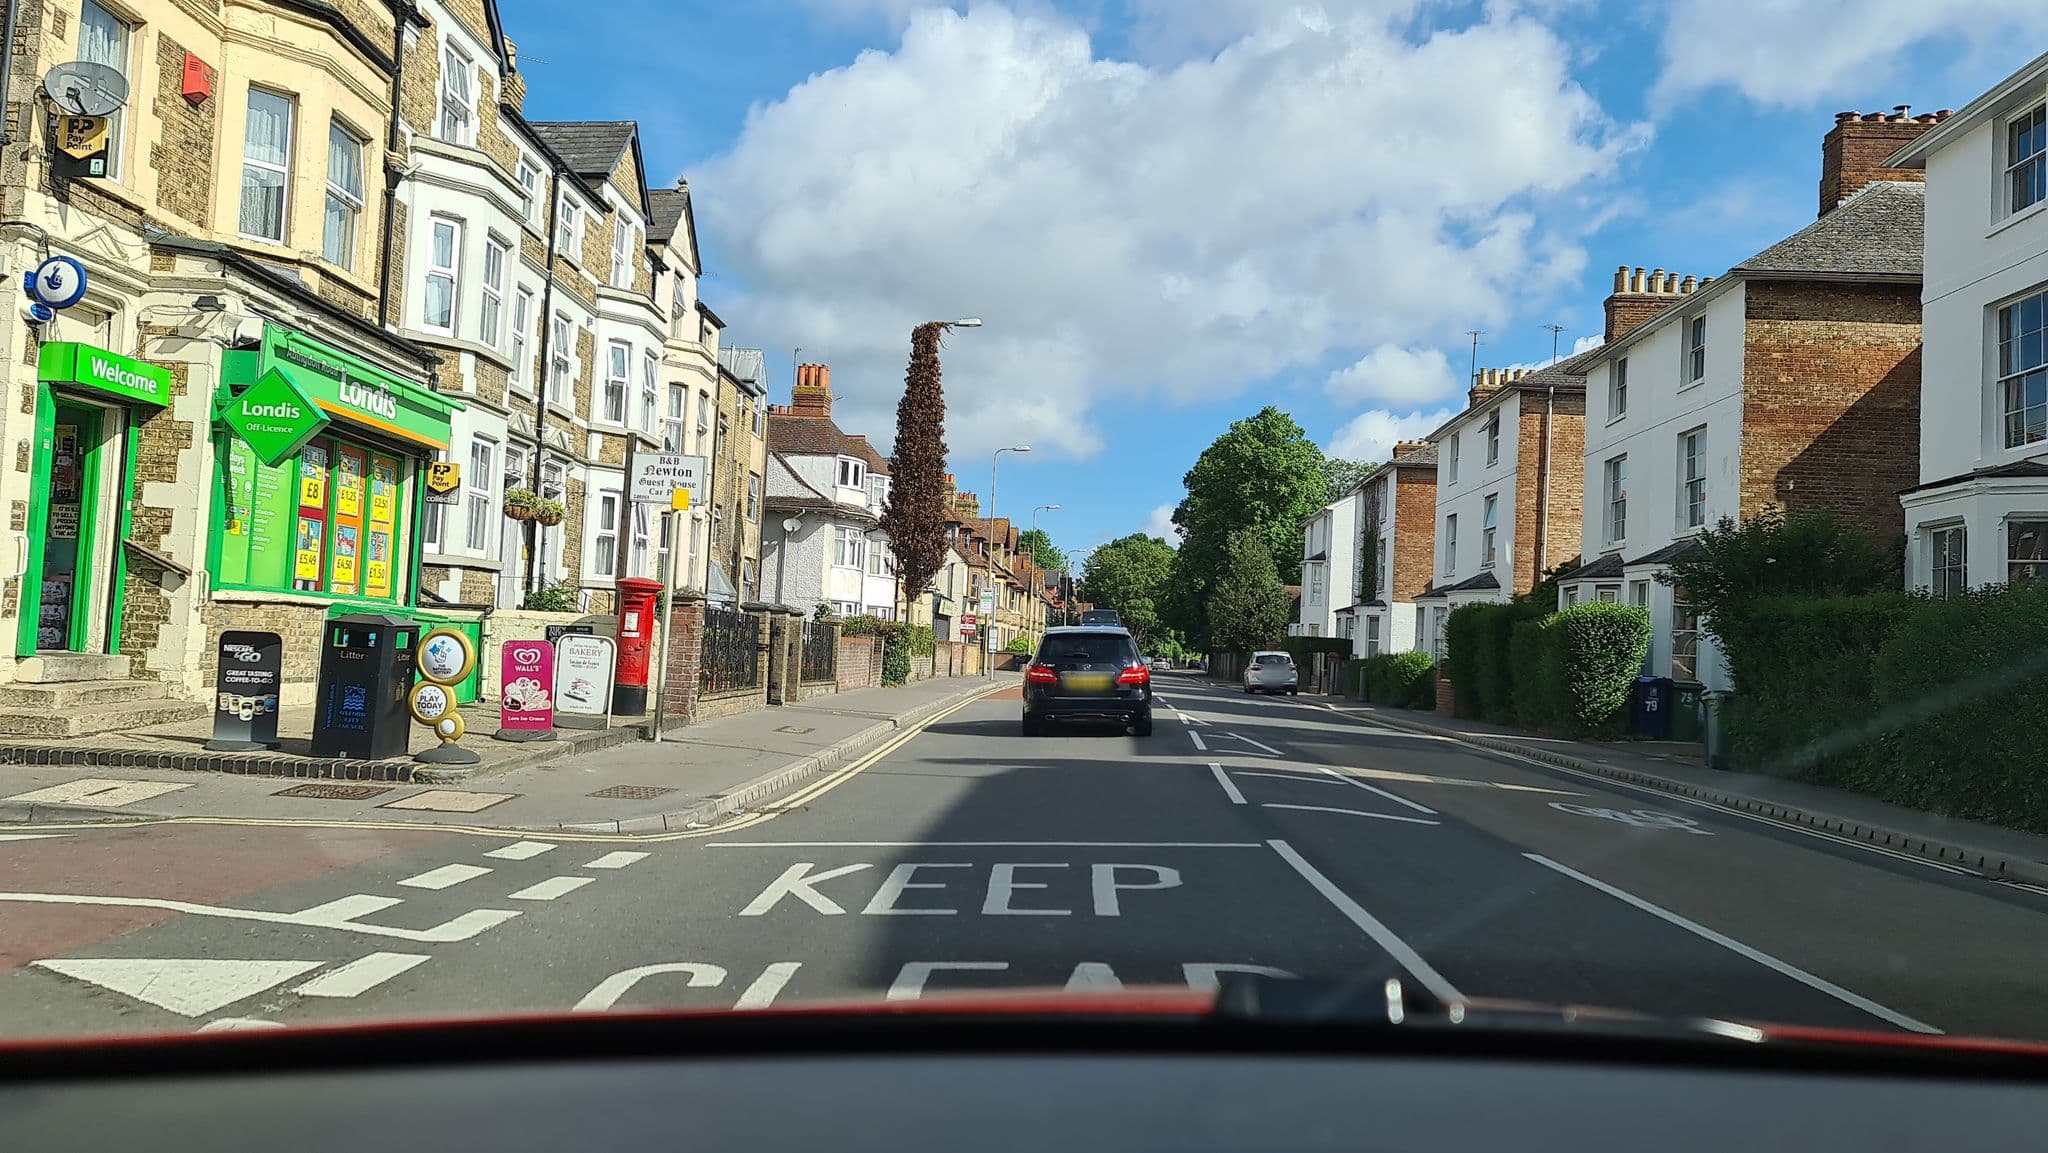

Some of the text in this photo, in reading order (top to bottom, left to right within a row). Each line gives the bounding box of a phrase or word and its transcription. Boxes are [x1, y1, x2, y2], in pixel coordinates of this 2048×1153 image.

[67, 133, 85, 143] Pay
[66, 142, 92, 151] Point
[286, 347, 339, 376] Abingdon Road
[91, 356, 158, 394] Welcome
[339, 371, 397, 420] Londis
[242, 400, 300, 419] Londis
[246, 423, 294, 434] Off-Licence
[660, 456, 680, 465] B&B
[643, 465, 692, 478] Newton
[638, 478, 696, 488] Guest House
[307, 482, 319, 499] £8
[648, 488, 663, 496] Car
[299, 553, 316, 566] £5.49
[337, 558, 353, 570] £4.50
[340, 650, 365, 660] Litter
[569, 648, 603, 657] BAKERY
[226, 669, 274, 678] GREAT TASTING
[417, 701, 443, 709] TODAY
[1645, 700, 1658, 712] 79
[738, 862, 1183, 917] KEEP
